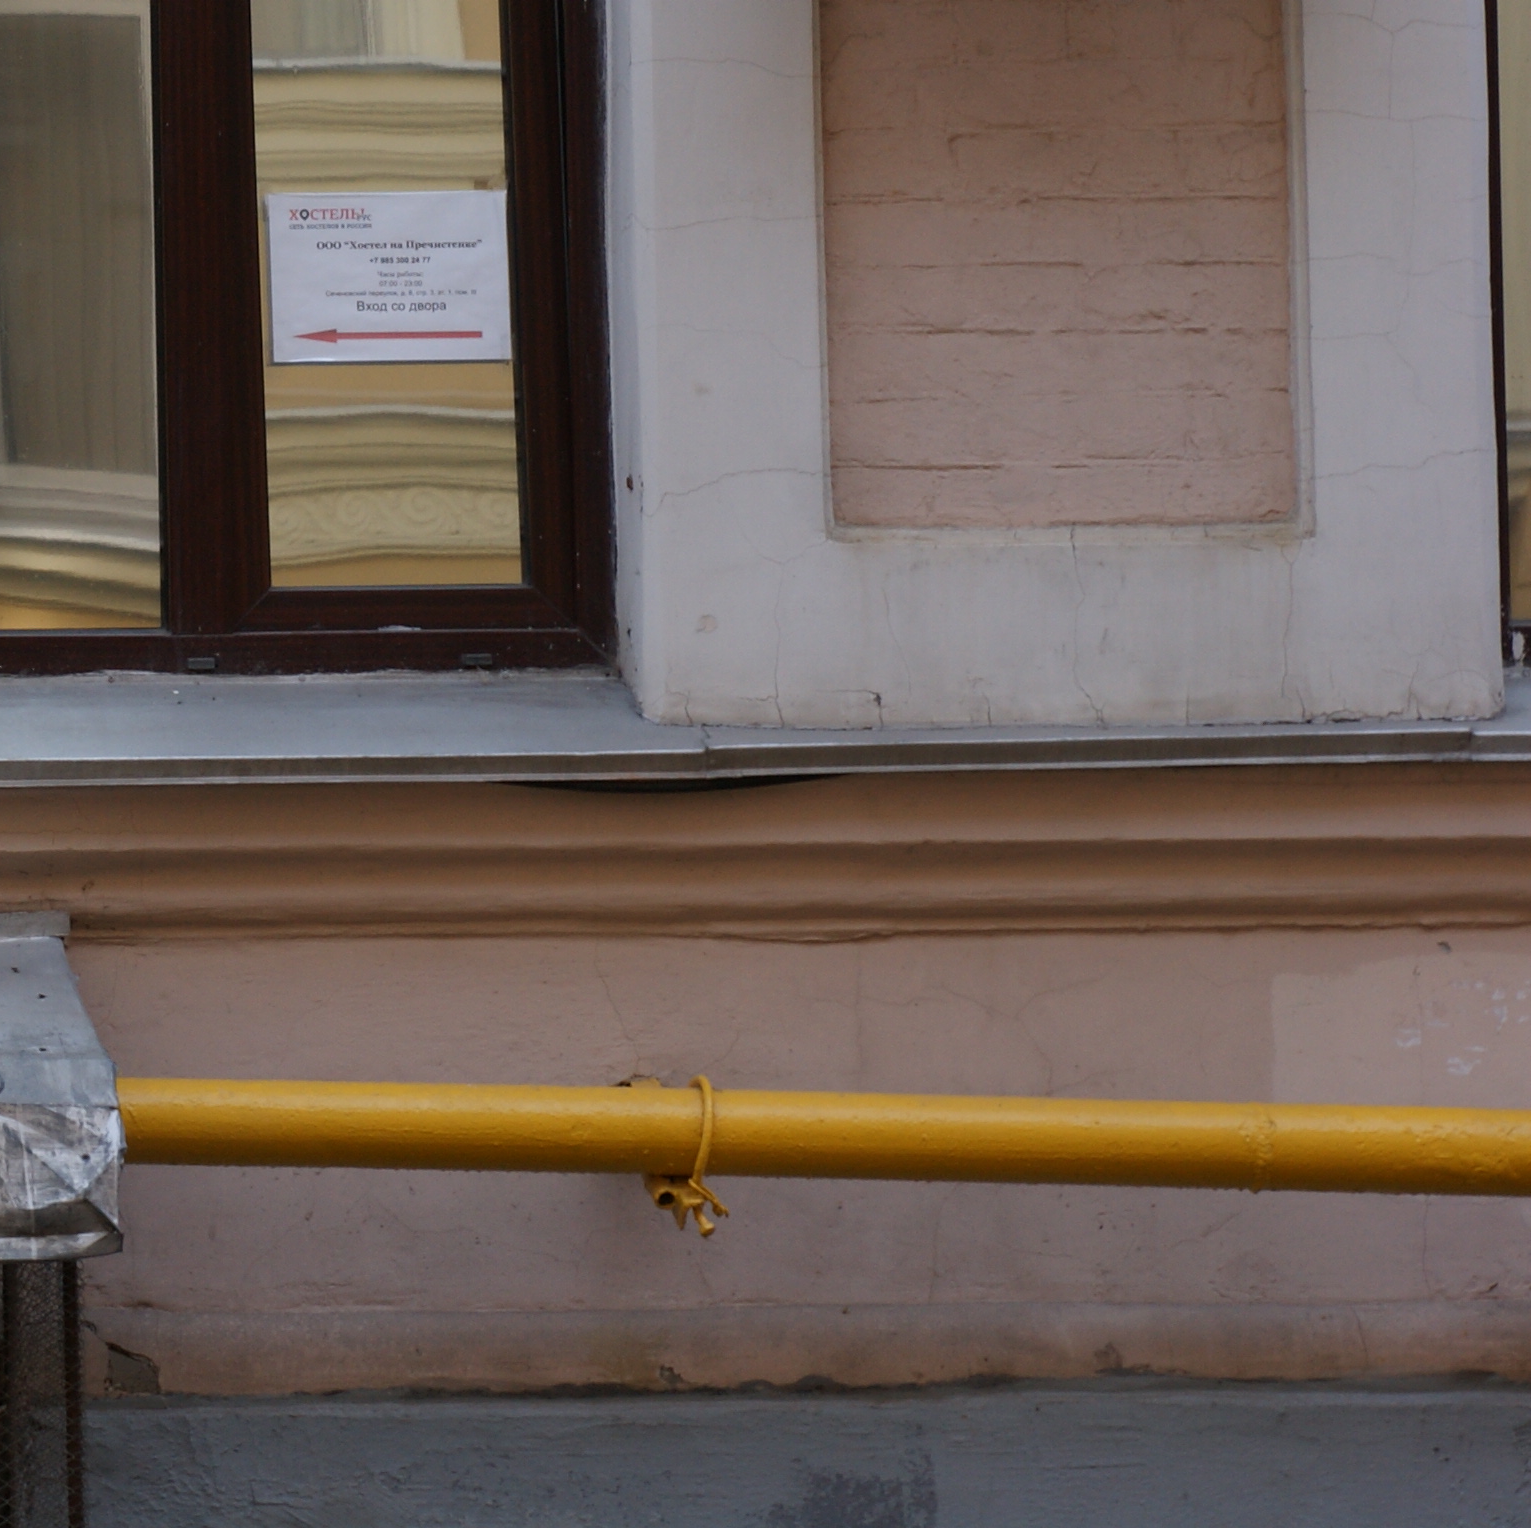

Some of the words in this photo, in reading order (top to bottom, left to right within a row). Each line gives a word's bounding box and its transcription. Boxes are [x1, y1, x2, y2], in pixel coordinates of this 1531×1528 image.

[316, 241, 341, 250] ООО
[356, 301, 387, 312] Вход
[391, 303, 405, 311] со
[409, 302, 447, 313] двора
